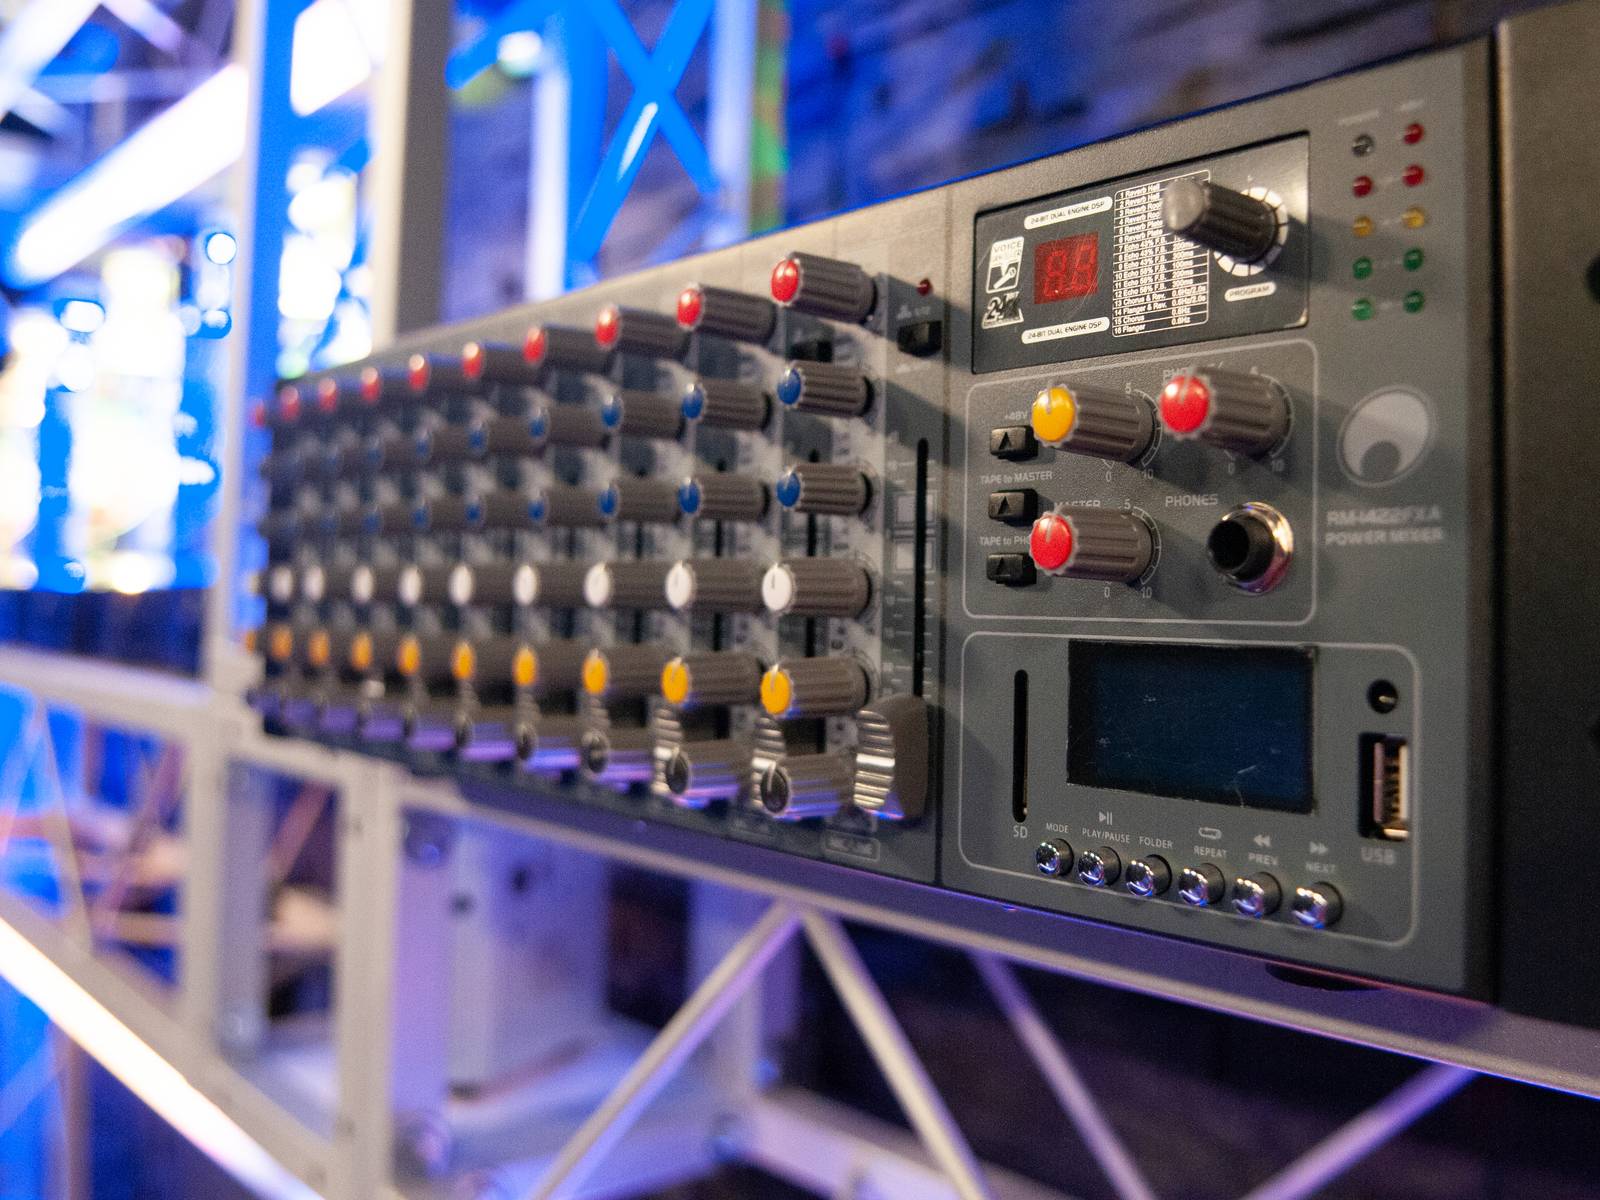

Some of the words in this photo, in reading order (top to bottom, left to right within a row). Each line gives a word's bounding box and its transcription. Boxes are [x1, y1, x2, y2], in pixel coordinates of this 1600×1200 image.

[1125, 187, 1147, 197] Reverb
[1125, 196, 1147, 206] Reverb
[1050, 212, 1066, 221] DUAL
[1067, 206, 1089, 216] ENGINE
[1091, 201, 1105, 210] DSP
[1125, 205, 1147, 215] Reverb
[1125, 214, 1147, 224] Reverb
[1125, 223, 1146, 233] Reverb
[1124, 232, 1146, 242] Reverb
[1124, 242, 1139, 252] Echo
[1124, 251, 1139, 261] Echo
[1123, 261, 1139, 270] Echo
[1123, 270, 1139, 279] Echo
[1123, 279, 1139, 288] Echo
[1123, 289, 1138, 298] Echo
[1229, 285, 1270, 298] PROGRAM
[1123, 297, 1145, 306] Chorus
[1152, 292, 1166, 301] Rev.
[1123, 305, 1146, 316] Flanger
[1153, 301, 1167, 310] Rev.
[1123, 315, 1145, 324] Chorus
[1047, 328, 1063, 336] DUAL
[1065, 323, 1087, 333] ENGINE
[1089, 320, 1102, 329] DSP
[1122, 324, 1146, 334] Flanger
[1125, 382, 1132, 394] 5
[1004, 410, 1028, 421] +48V
[1228, 462, 1235, 475] 0
[1271, 459, 1285, 472] 10
[981, 473, 1001, 484] TAPE
[1003, 473, 1012, 482] to
[1014, 471, 1053, 482] MASTER
[1105, 471, 1112, 482] 0
[1142, 468, 1154, 480] 10
[1124, 499, 1131, 510] 5
[1165, 494, 1218, 507] PHONES
[980, 535, 1001, 546] TAPE
[1003, 535, 1012, 544] to
[1326, 530, 1387, 545] POWER
[1104, 586, 1110, 598] 0
[1141, 586, 1153, 598] 10
[1013, 825, 1028, 839] SD
[1046, 822, 1069, 834] MODE
[1082, 827, 1131, 844] PLAY/PAUSE
[1139, 836, 1174, 849] FOLDER
[1194, 845, 1227, 859] REPEAT
[1360, 846, 1396, 865] USB
[1249, 852, 1279, 866] PREV
[1306, 862, 1337, 874] NEXT
